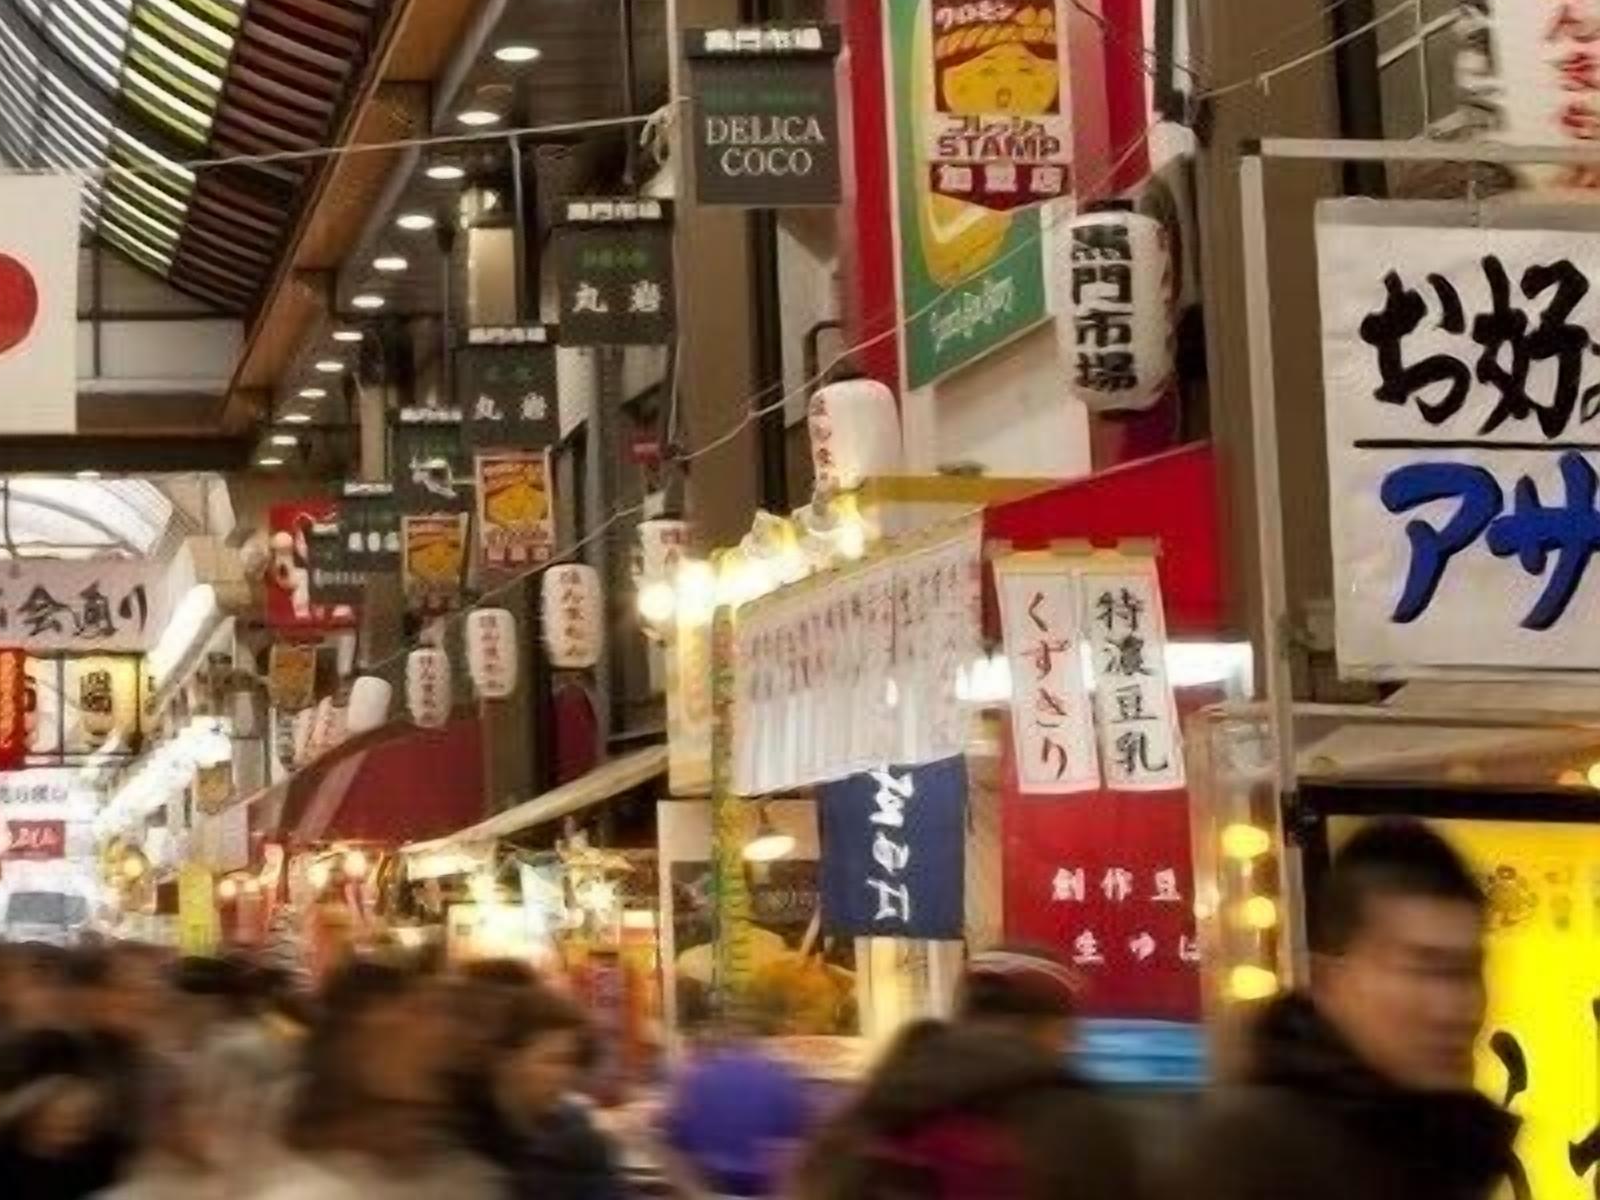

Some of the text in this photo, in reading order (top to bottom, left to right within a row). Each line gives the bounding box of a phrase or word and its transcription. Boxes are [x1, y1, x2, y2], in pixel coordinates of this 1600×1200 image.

[704, 115, 825, 146] DELICA
[719, 147, 813, 177] COCO
[1071, 223, 1138, 394] 黒門市場
[1360, 254, 1600, 438] お好
[1021, 592, 1072, 780] くずきり
[1095, 588, 1169, 778] 特濃豆乳
